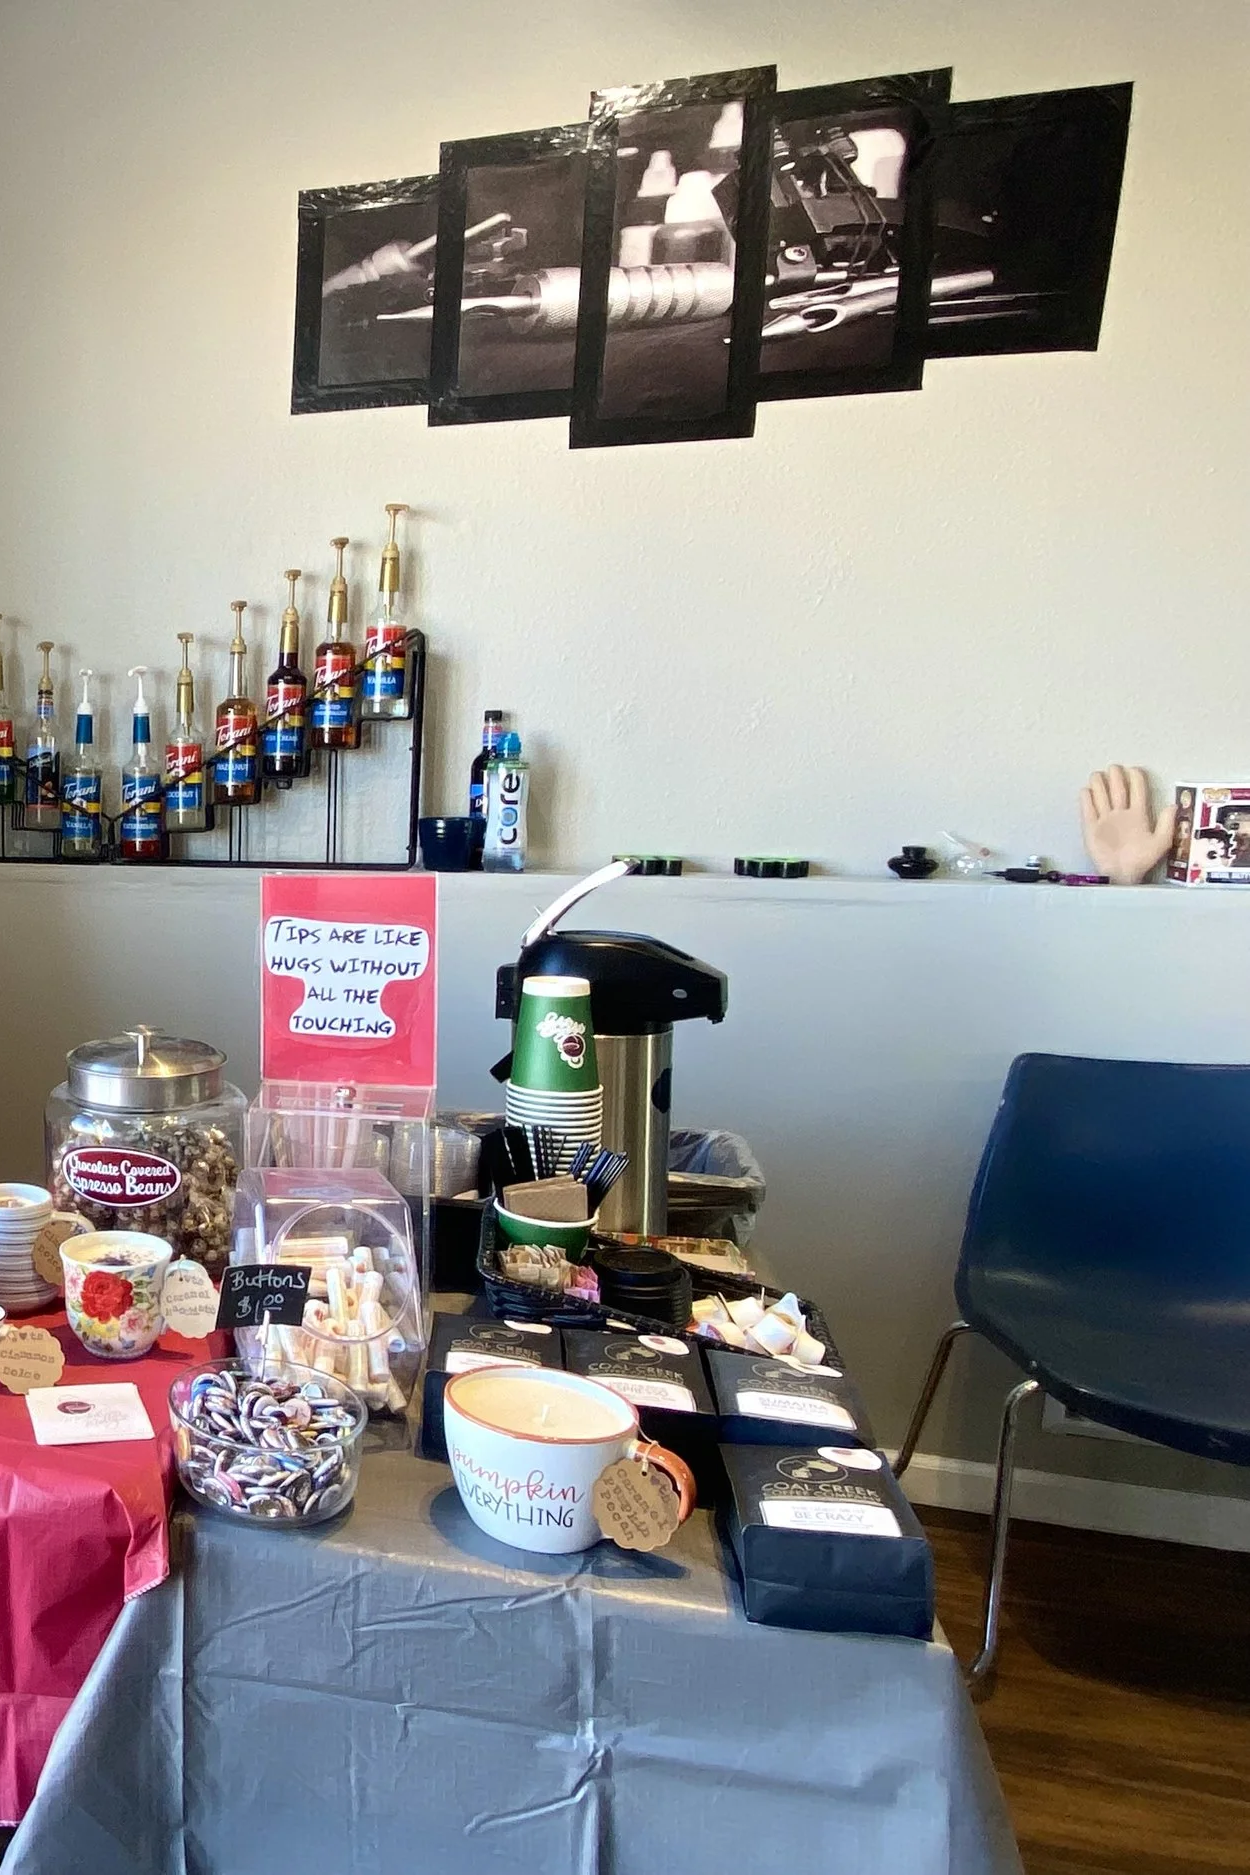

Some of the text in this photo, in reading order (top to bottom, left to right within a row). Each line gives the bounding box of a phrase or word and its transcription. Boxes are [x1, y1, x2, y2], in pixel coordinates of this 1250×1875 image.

[64, 781, 98, 800] Torani
[122, 781, 156, 800] Torani
[500, 773, 521, 845] core
[328, 927, 367, 944] ARE
[374, 929, 423, 946] LIKE
[270, 956, 422, 977] HUGS WITHOUT
[307, 986, 379, 1005] ALL THE
[293, 1015, 392, 1035] TOUCHING
[68, 1154, 170, 1177] Chocolate Covered
[70, 1169, 172, 1196] Espresso Beans
[230, 1269, 306, 1292] Buttons
[458, 1470, 575, 1528] EVERYTHING
[761, 1481, 879, 1498] COAL CREEK
[815, 1511, 864, 1522] CRAZY
